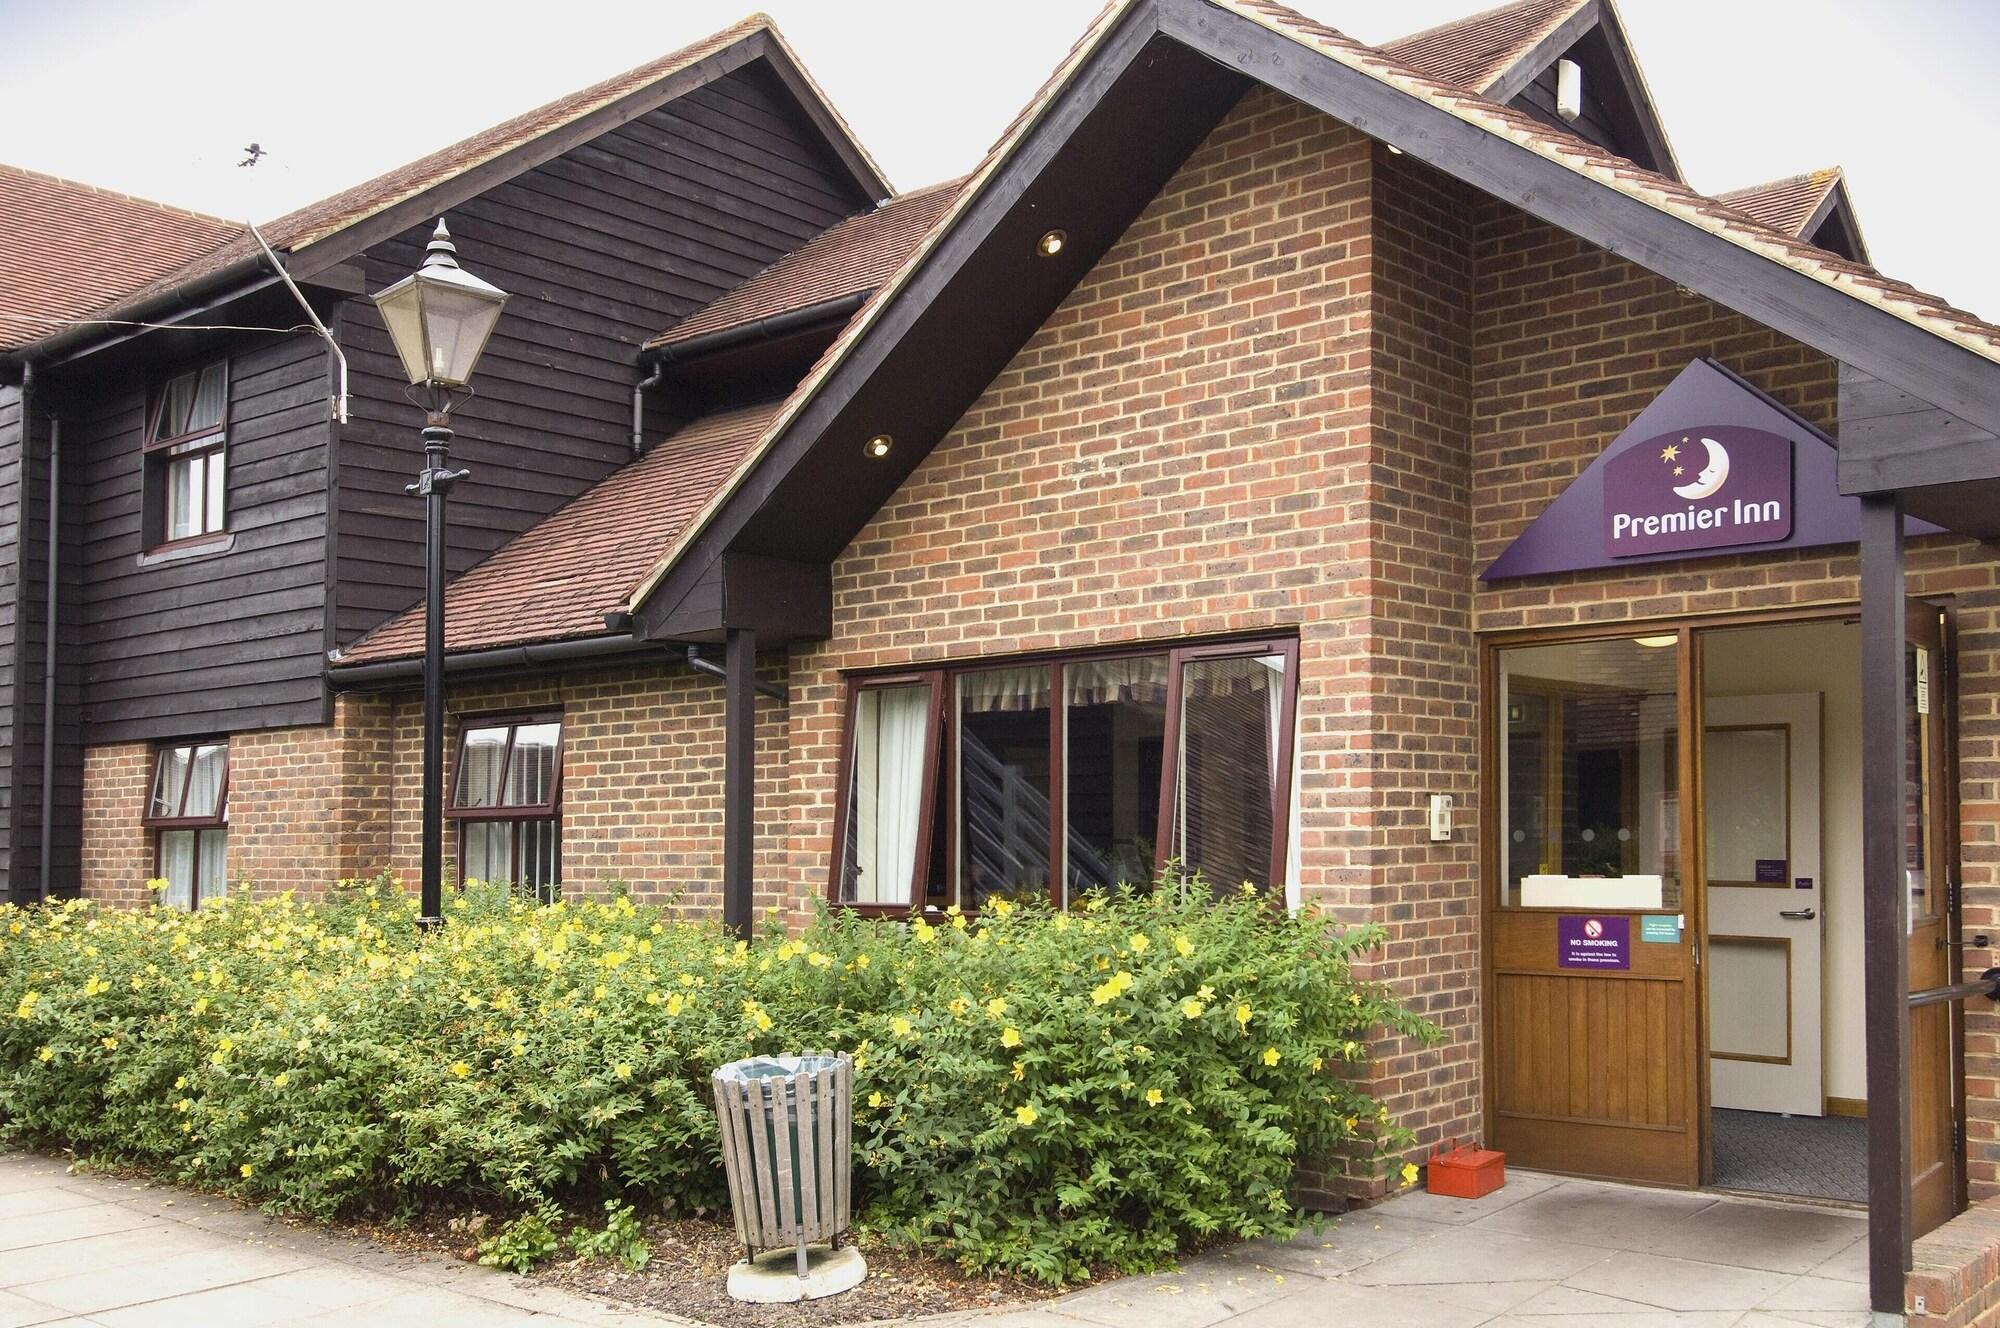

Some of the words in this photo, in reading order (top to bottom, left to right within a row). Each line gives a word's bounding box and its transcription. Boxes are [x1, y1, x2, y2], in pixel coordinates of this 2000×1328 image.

[1613, 505, 1729, 539] Premier
[1734, 499, 1780, 525] Inn
[1582, 939, 1618, 947] SMOKING
